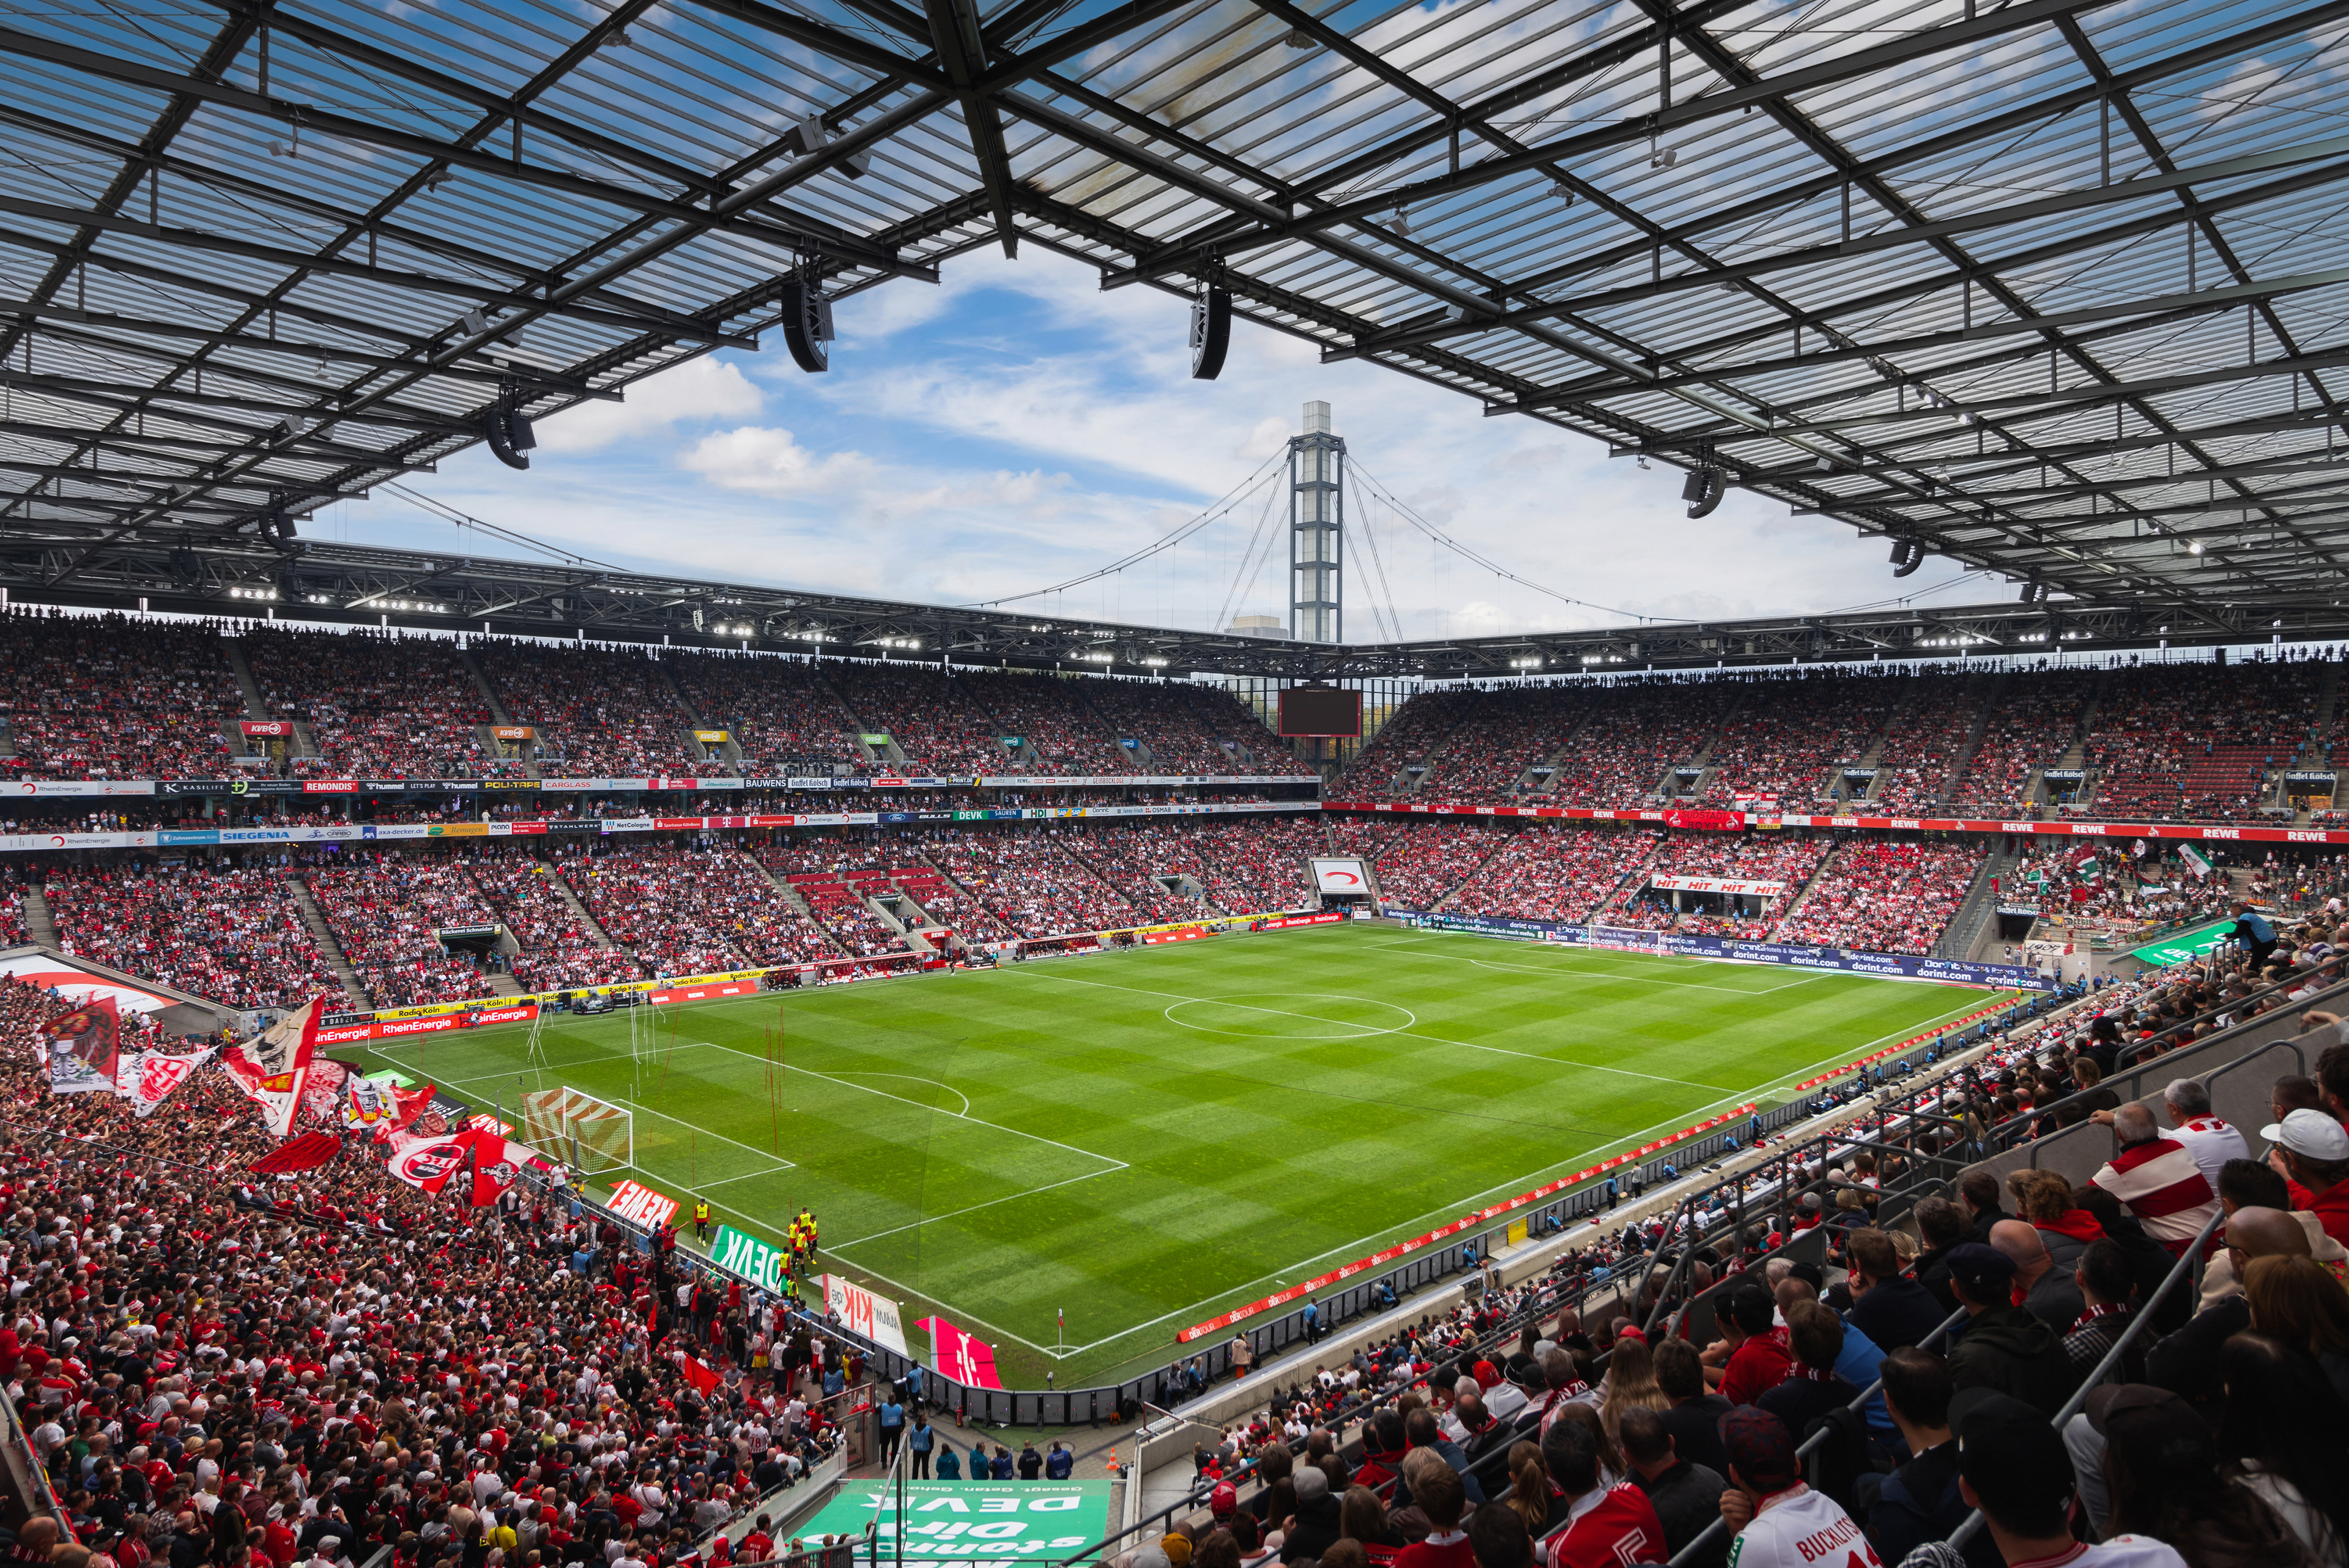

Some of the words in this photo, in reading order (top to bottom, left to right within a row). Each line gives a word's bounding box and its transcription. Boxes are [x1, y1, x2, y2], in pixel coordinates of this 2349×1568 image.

[959, 811, 982, 820] DEVK
[1031, 809, 1047, 817] HDI
[2073, 825, 2106, 834] REWE
[2203, 828, 2240, 838] REWE
[2288, 831, 2326, 841] REWE
[1688, 881, 1712, 890] HIT
[1721, 883, 1746, 892] HIT
[1754, 886, 1781, 894] HIT
[1733, 951, 1779, 962] dorint.com
[1791, 956, 1839, 967] dorint.com
[1852, 962, 1902, 974] dorint.com
[1917, 968, 1971, 981] dorint.com
[383, 1019, 451, 1034] RheinEnergie
[363, 1112, 377, 1121] 1996
[612, 1181, 675, 1229] REWE
[719, 1231, 785, 1293] DEVK
[751, 1437, 761, 1447] 78
[860, 1493, 1080, 1512] DEVK
[750, 1549, 759, 1564] 11
